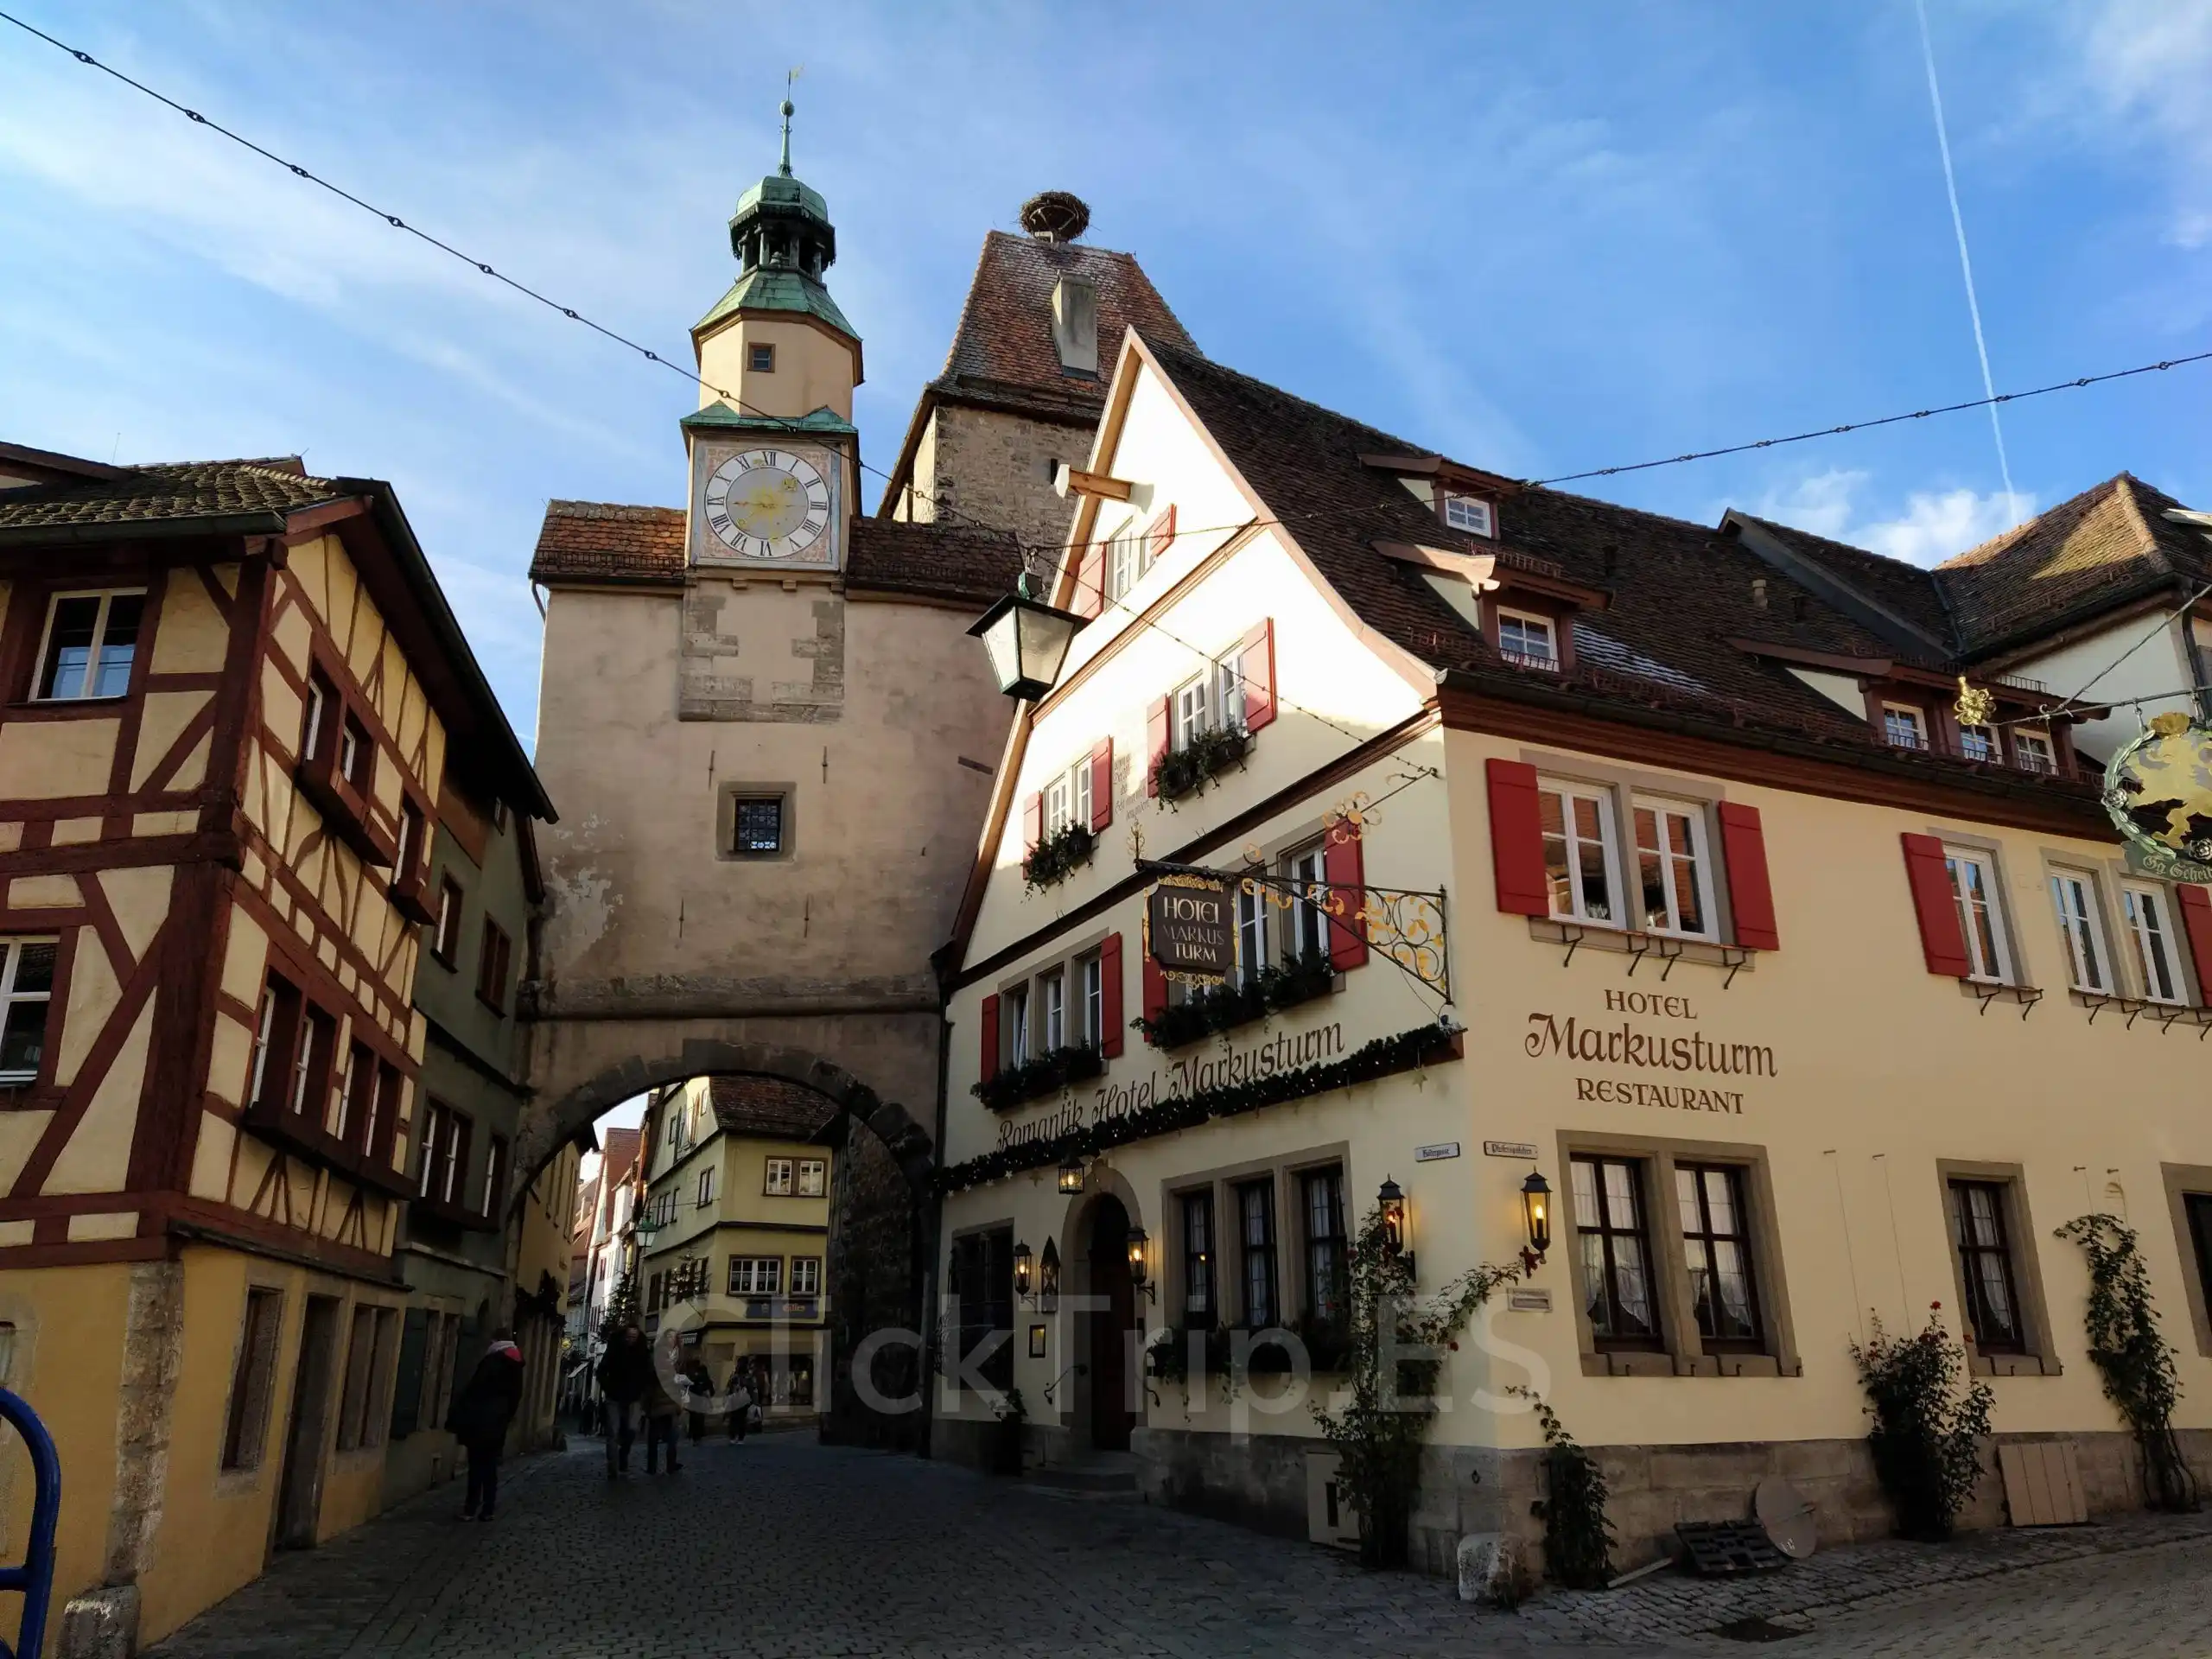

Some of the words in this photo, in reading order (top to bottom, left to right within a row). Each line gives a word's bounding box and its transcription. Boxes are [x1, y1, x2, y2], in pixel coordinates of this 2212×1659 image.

[734, 454, 751, 471] XI
[762, 451, 777, 466] XII
[788, 459, 799, 473] I
[714, 472, 733, 486] X
[804, 477, 822, 489] II
[707, 495, 725, 505] IX
[810, 500, 828, 511] III
[710, 513, 732, 536] VIII
[802, 518, 822, 537] IIII
[729, 532, 747, 552] VII
[760, 540, 772, 556] VI
[788, 537, 802, 551] V
[1163, 925, 1225, 945] MARKUS
[1173, 942, 1217, 963] TURM
[1604, 988, 1698, 1020] HOTEL
[1525, 1013, 1778, 1077] Markusturm
[995, 1098, 1084, 1153] Romantik
[1091, 1070, 1160, 1125] Hotel
[1168, 1022, 1345, 1102] Markusturm
[1576, 1077, 1744, 1115] RESTAURANT
